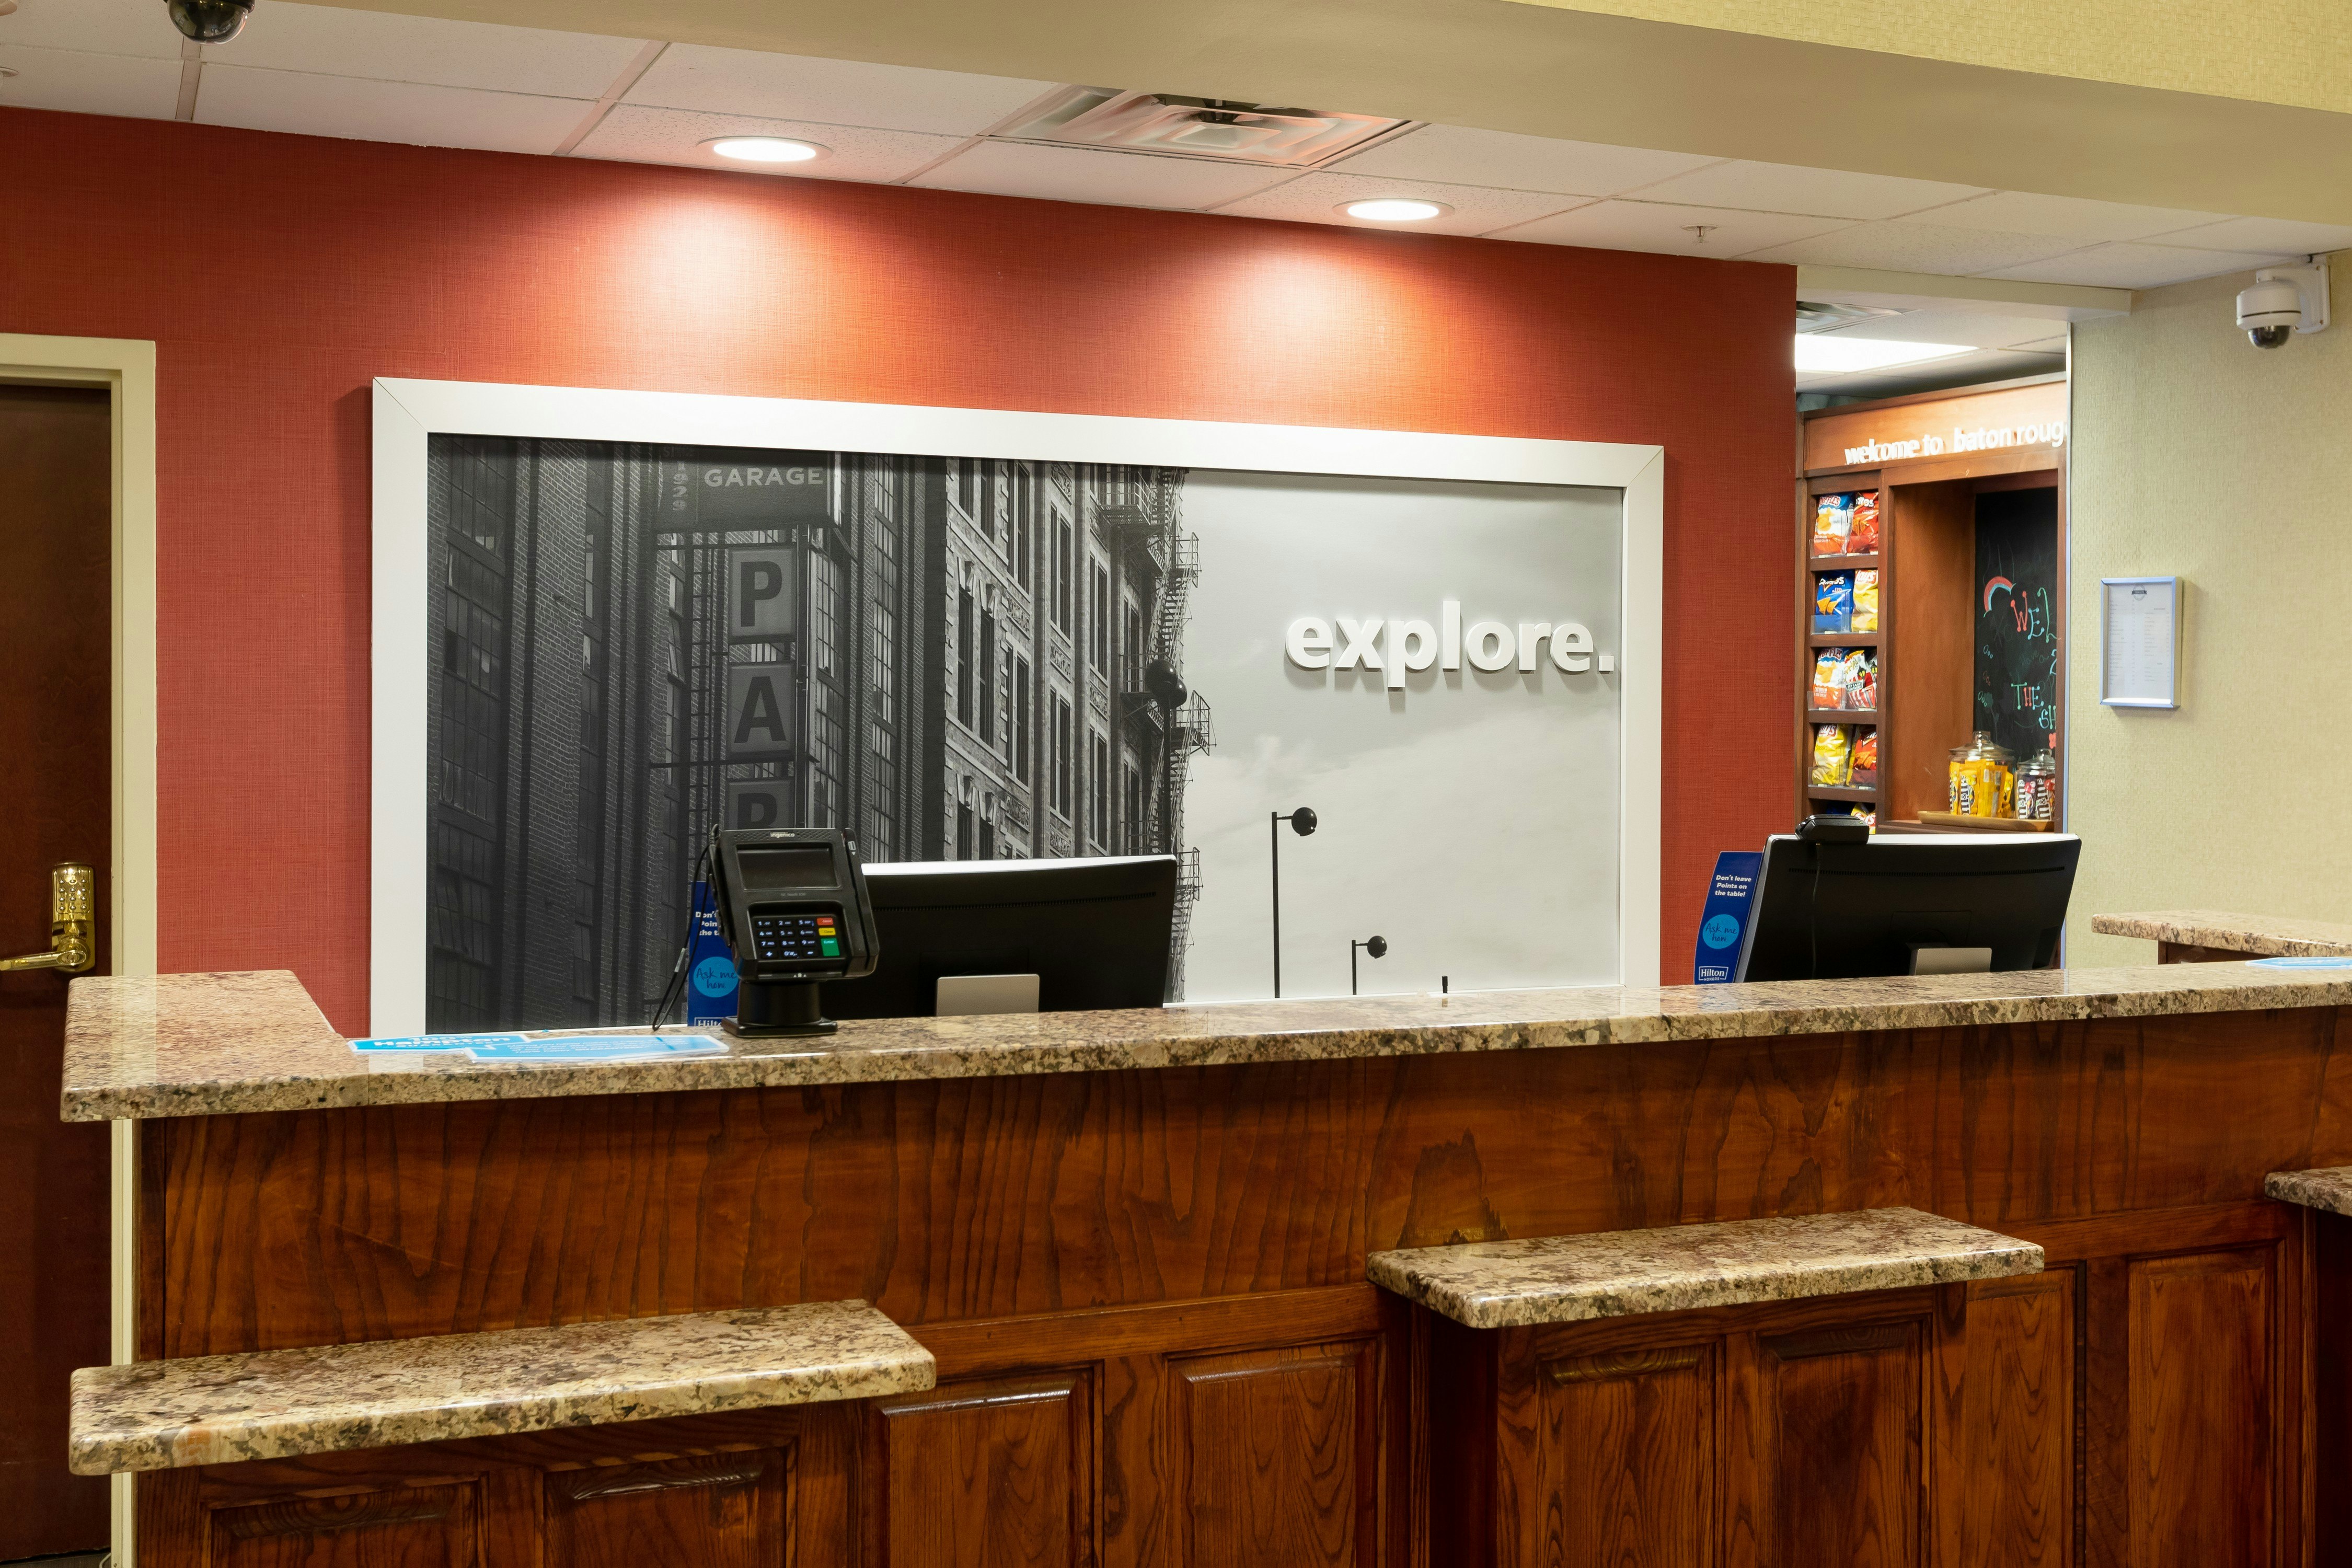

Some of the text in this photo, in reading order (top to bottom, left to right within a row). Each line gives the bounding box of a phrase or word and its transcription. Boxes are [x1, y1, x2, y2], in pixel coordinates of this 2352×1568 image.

[1844, 421, 2067, 465] welcome to baton roug
[704, 467, 824, 487] GARAGE
[1285, 601, 1615, 691] explore.
[2011, 682, 2044, 710] THE
[1705, 923, 1723, 933] Ask
[696, 967, 737, 980] Ask me
[373, 1037, 511, 1046] Hampton
